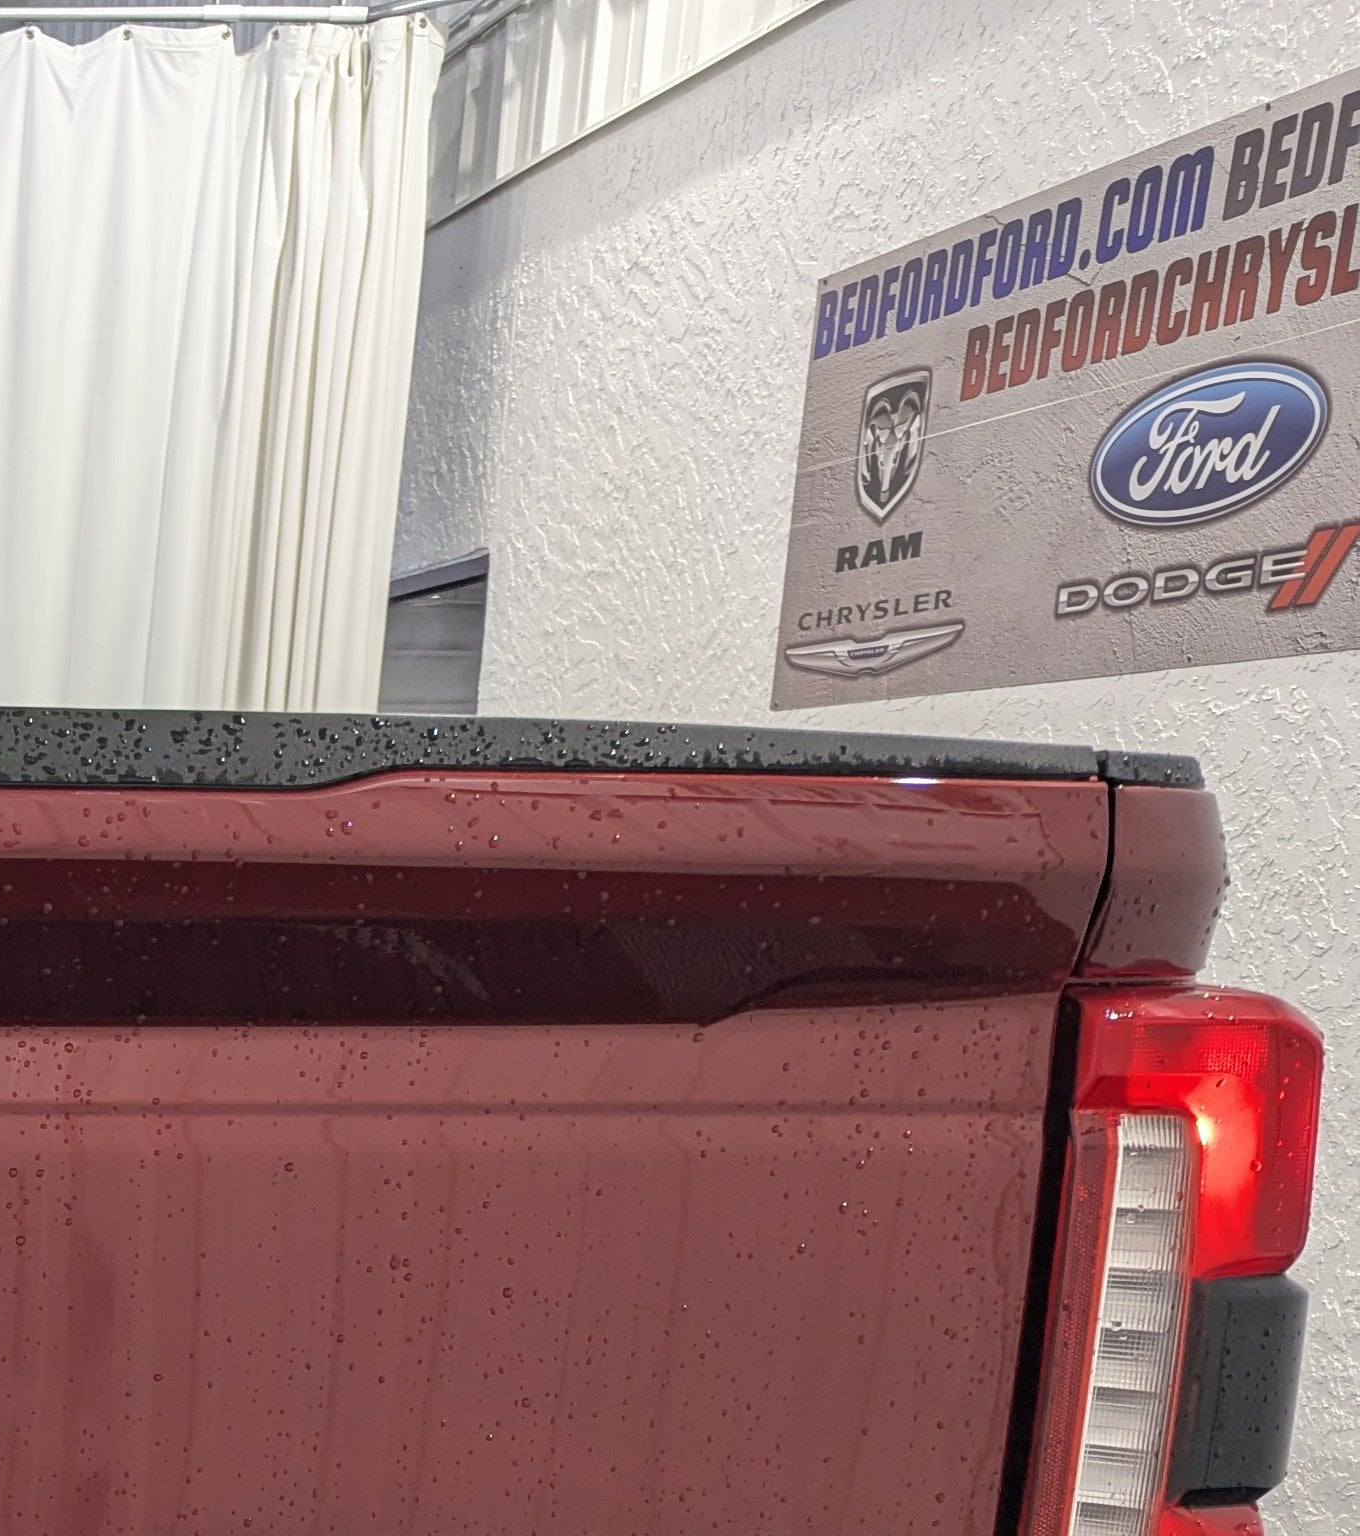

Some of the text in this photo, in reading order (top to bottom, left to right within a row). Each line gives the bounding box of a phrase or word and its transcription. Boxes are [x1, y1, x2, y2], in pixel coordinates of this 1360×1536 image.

[813, 145, 1214, 360] BEDFORDFORD.COM
[1129, 391, 1281, 501] Ford
[835, 531, 923, 573] RAM
[1056, 549, 1308, 614] DODGE
[798, 589, 952, 631] CHRYSLER
